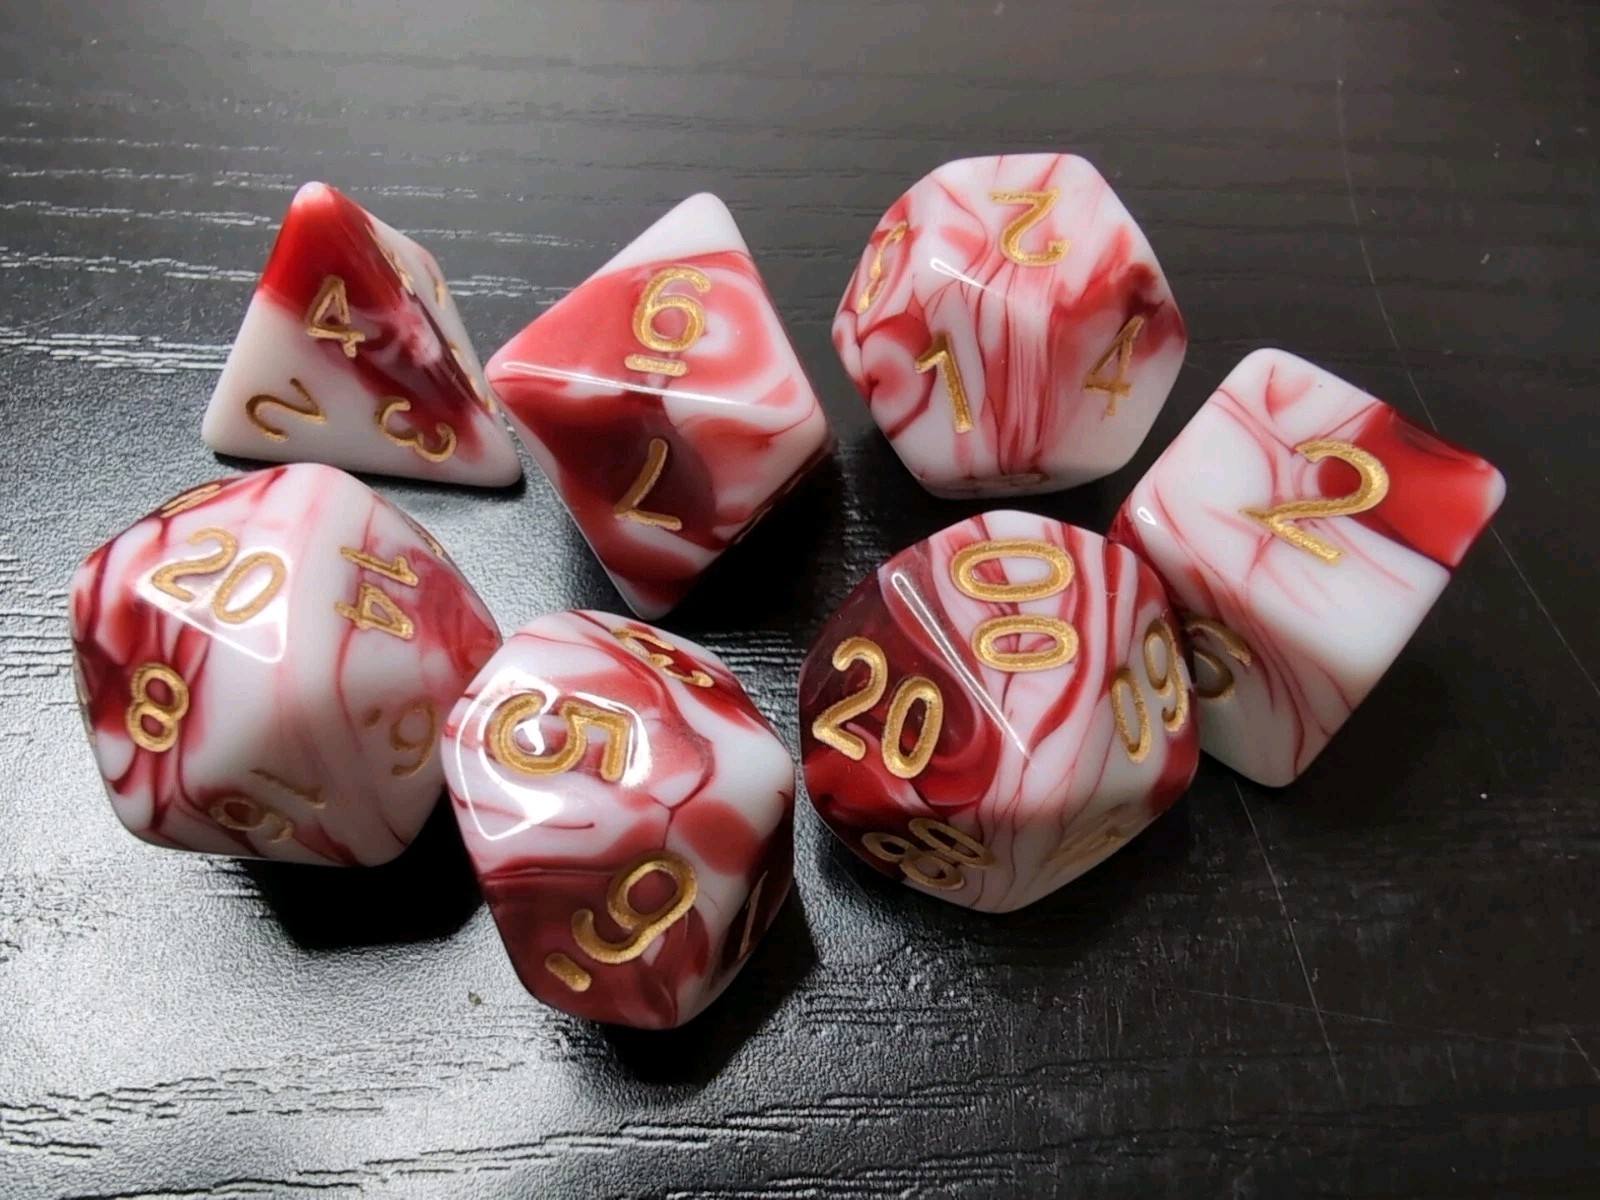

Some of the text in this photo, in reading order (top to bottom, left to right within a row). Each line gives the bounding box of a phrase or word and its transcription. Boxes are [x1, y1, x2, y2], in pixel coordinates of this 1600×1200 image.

[988, 188, 1072, 267] 2
[307, 274, 365, 359] 4
[245, 377, 326, 443] 2
[914, 333, 975, 434] 1
[1082, 314, 1145, 417] 4
[374, 397, 457, 463] 3
[1239, 438, 1390, 564] 2
[150, 527, 288, 625] 20
[334, 545, 420, 641] 14
[950, 539, 1080, 673] 00
[125, 661, 190, 753] 8
[485, 690, 632, 783] 5
[811, 636, 944, 779] 20
[860, 817, 999, 891] 80
